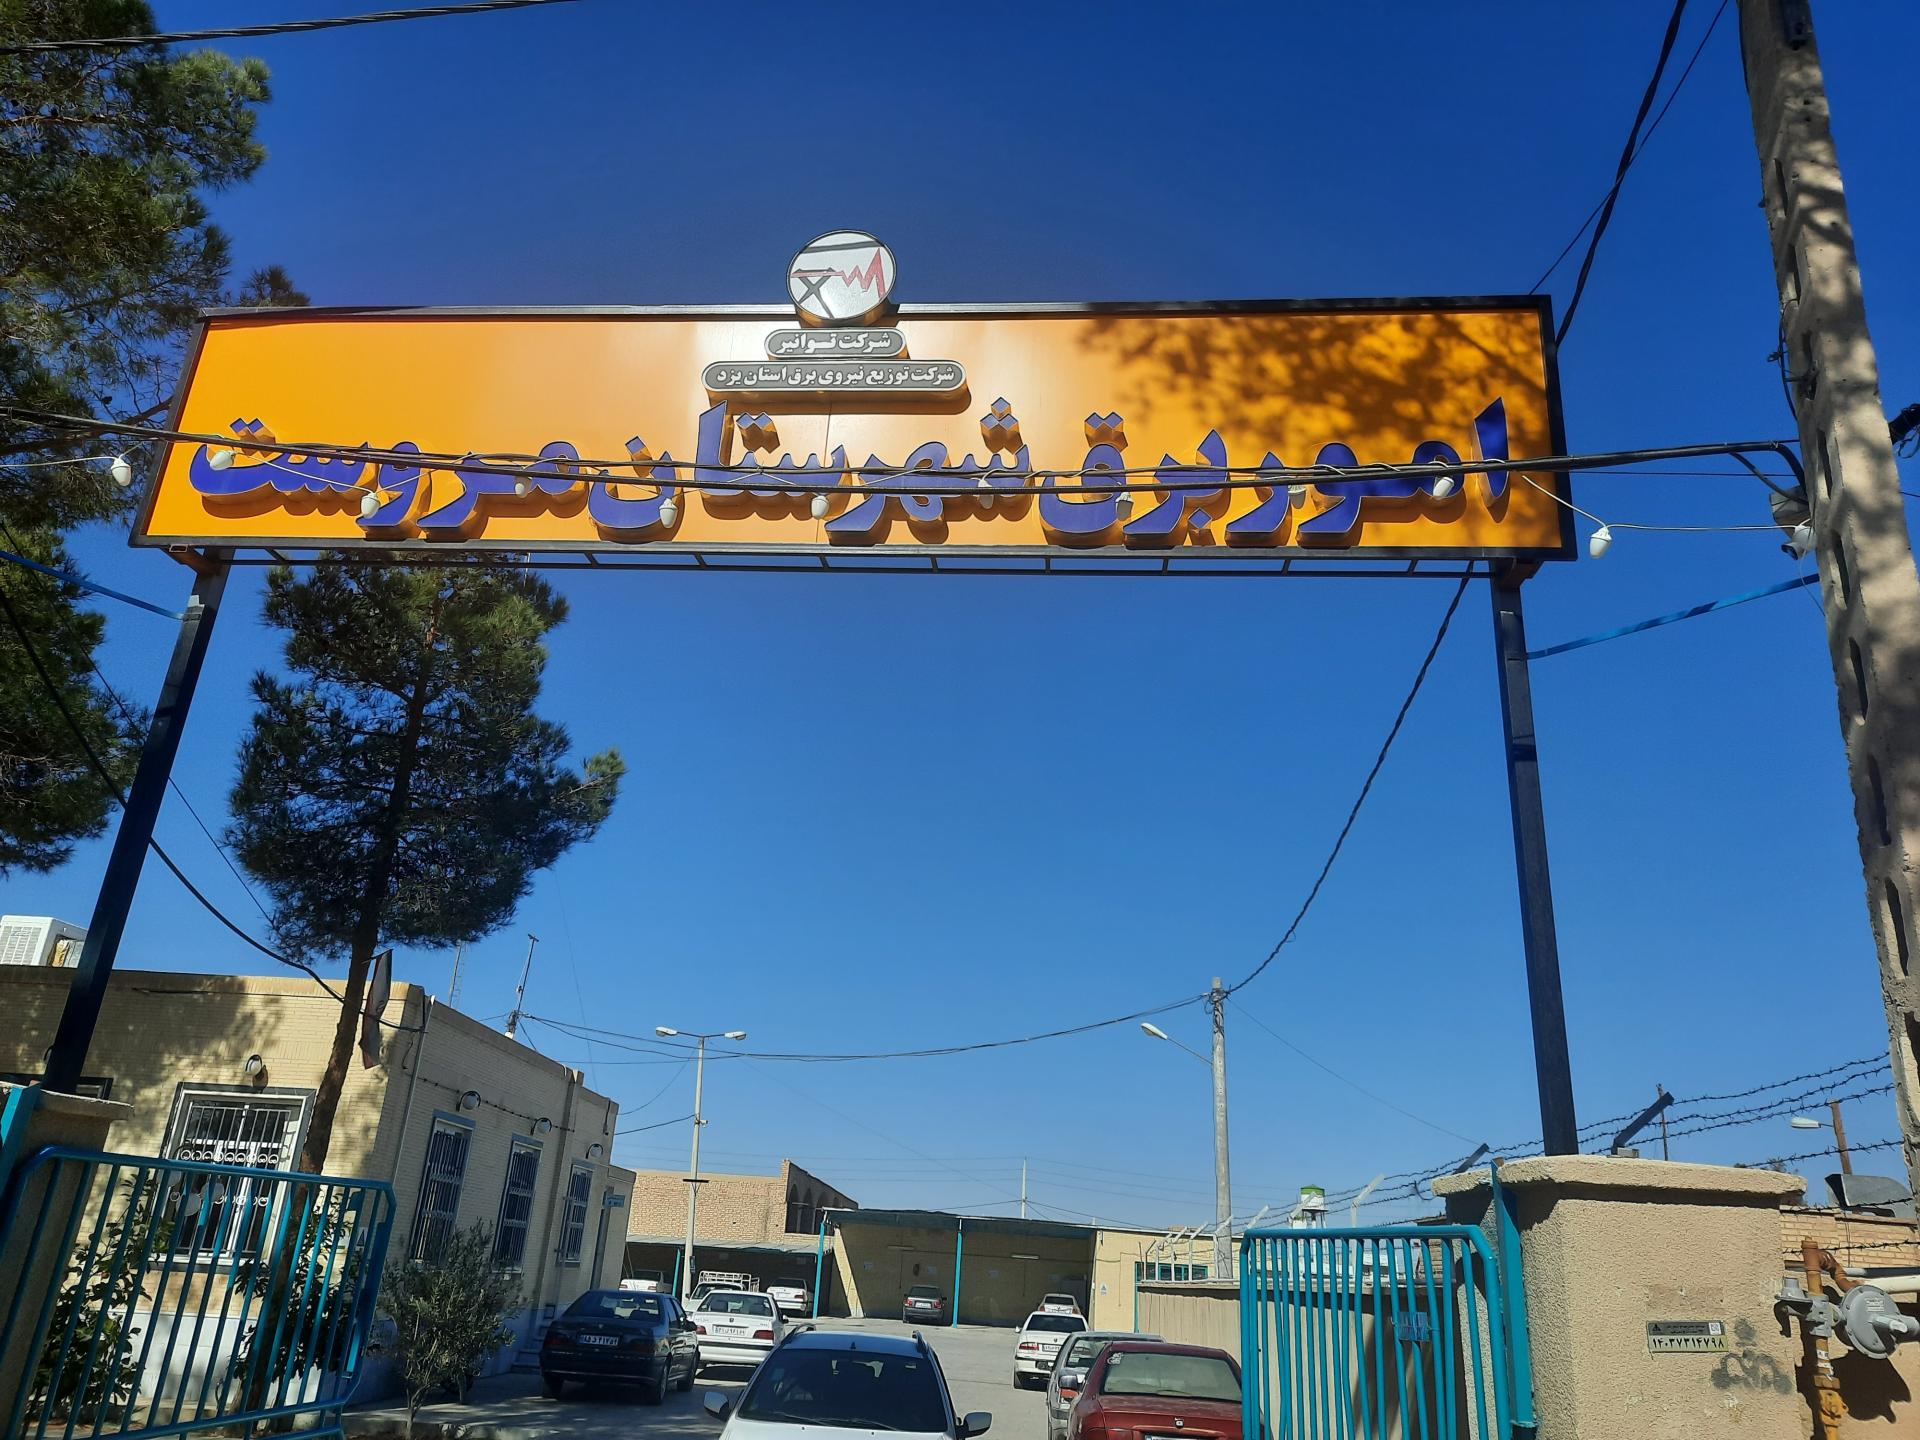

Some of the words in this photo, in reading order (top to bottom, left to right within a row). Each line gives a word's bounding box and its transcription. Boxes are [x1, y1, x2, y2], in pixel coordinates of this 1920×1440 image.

[775, 332, 837, 353] توانیر
[839, 331, 890, 350] شرکت
[716, 370, 742, 386] یزد
[744, 366, 787, 385] استان
[787, 367, 817, 386] برق
[818, 366, 864, 385] نیروی
[866, 366, 910, 385] توزیع
[910, 367, 954, 385] شرکت
[188, 417, 581, 529] مروست
[588, 396, 1032, 534] شهرستان
[1039, 411, 1230, 535] برق
[1226, 396, 1509, 534] امور
